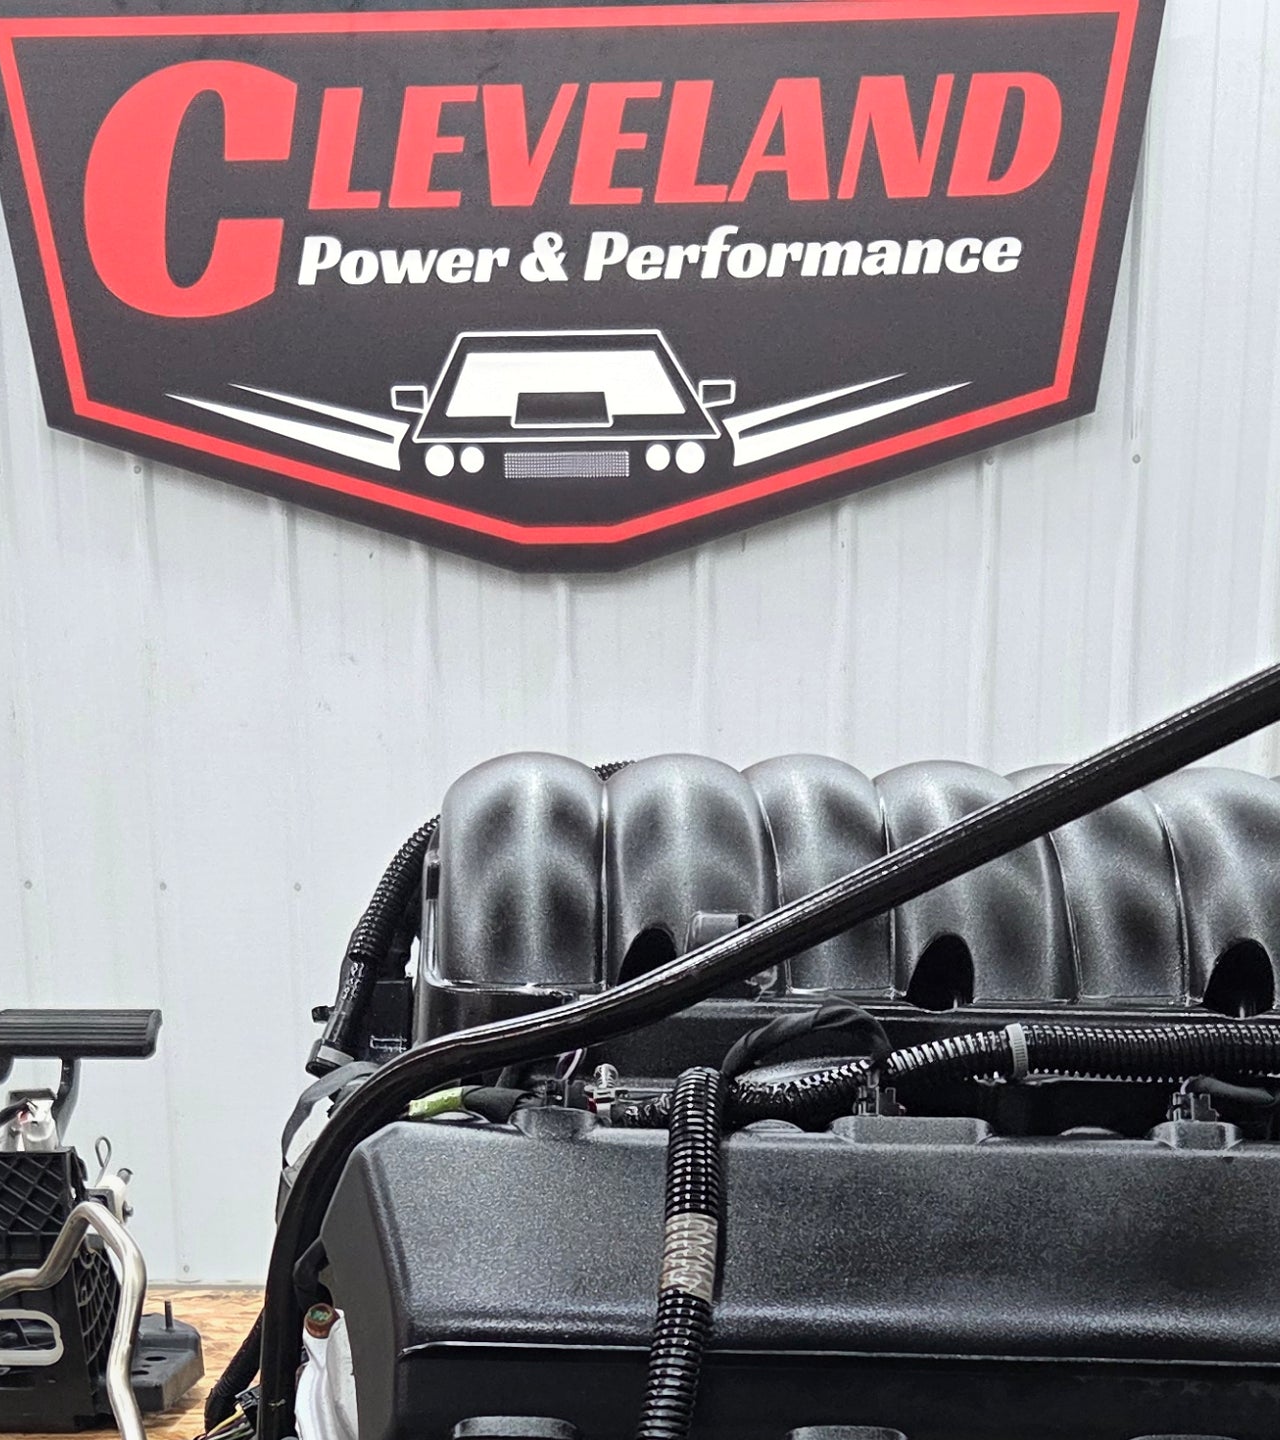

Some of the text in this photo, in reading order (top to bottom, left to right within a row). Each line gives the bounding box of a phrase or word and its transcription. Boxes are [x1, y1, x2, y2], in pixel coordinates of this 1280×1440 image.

[84, 61, 1062, 318] CLEVELAND
[298, 225, 1022, 286] Power & Performance
